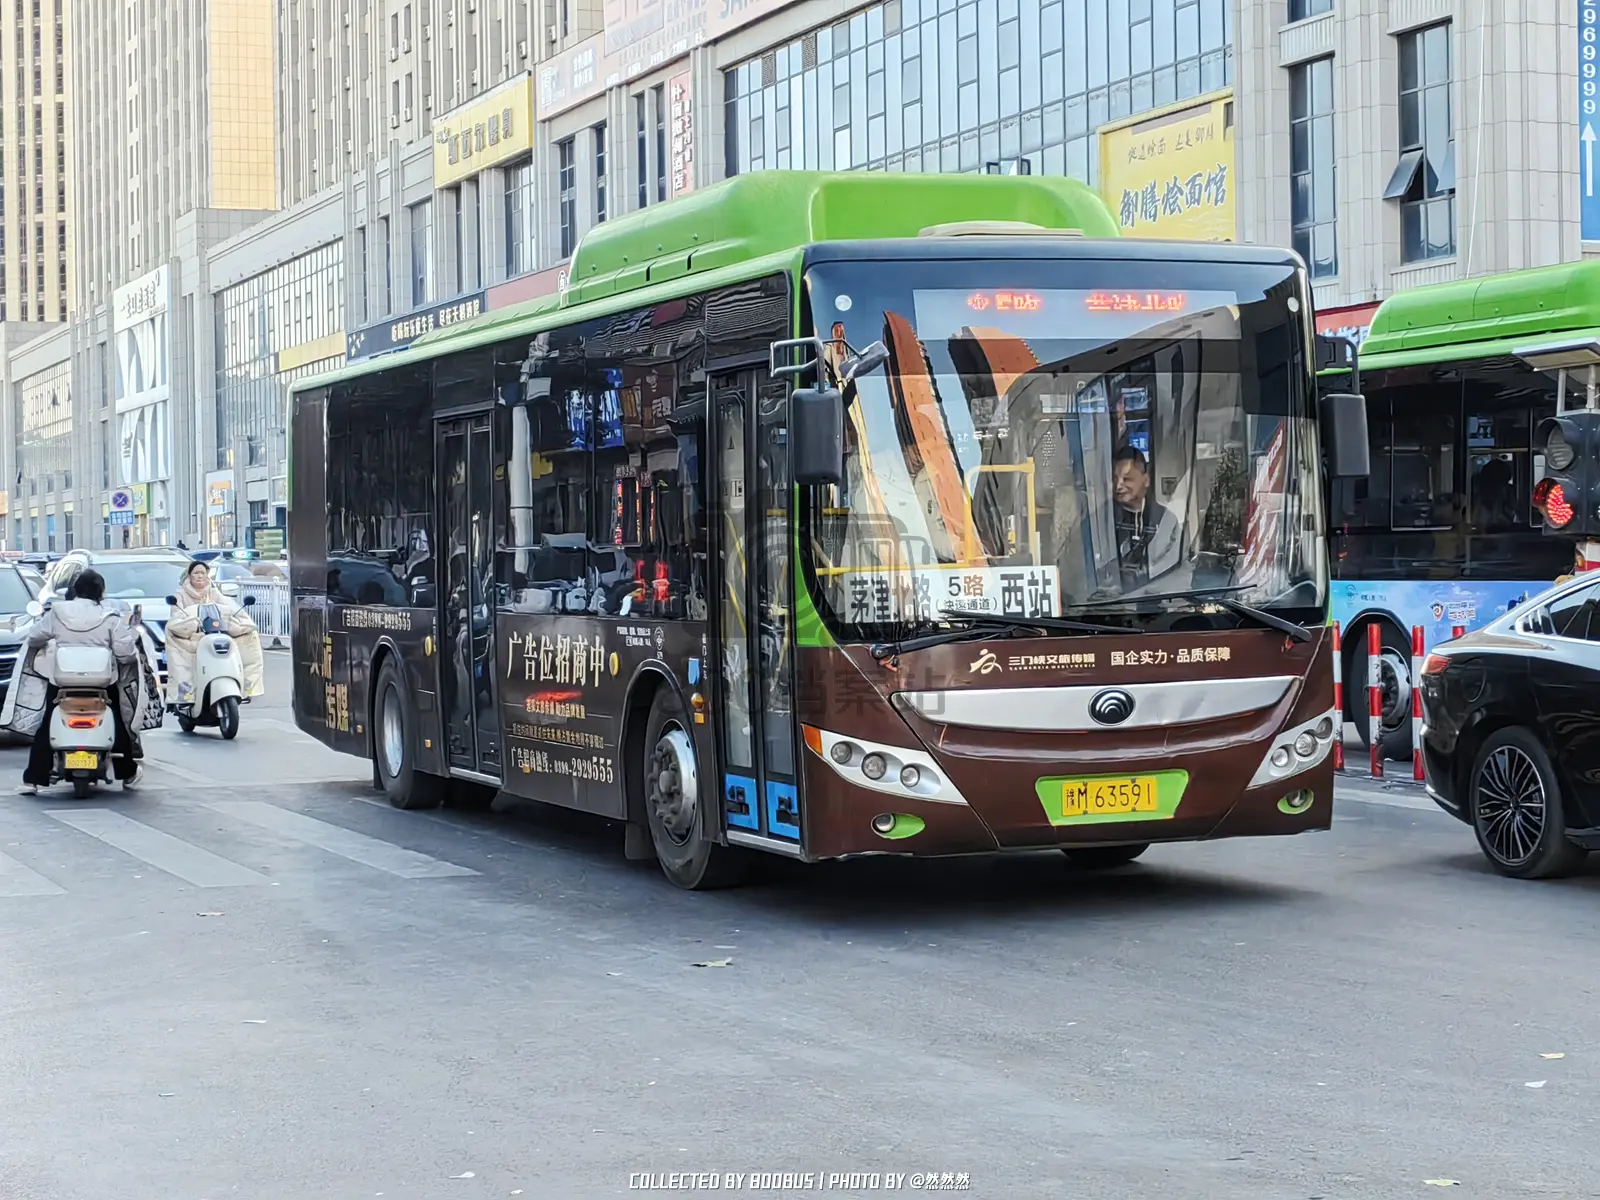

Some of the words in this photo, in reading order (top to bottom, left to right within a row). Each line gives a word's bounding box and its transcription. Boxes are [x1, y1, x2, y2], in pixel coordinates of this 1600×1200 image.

[1119, 163, 1228, 229] 御膳烩面馆
[948, 574, 984, 597] 5路
[1000, 569, 1053, 618] 西站
[506, 630, 605, 688] 广告位招商中
[1008, 653, 1096, 666] 三门峡文旅传媒
